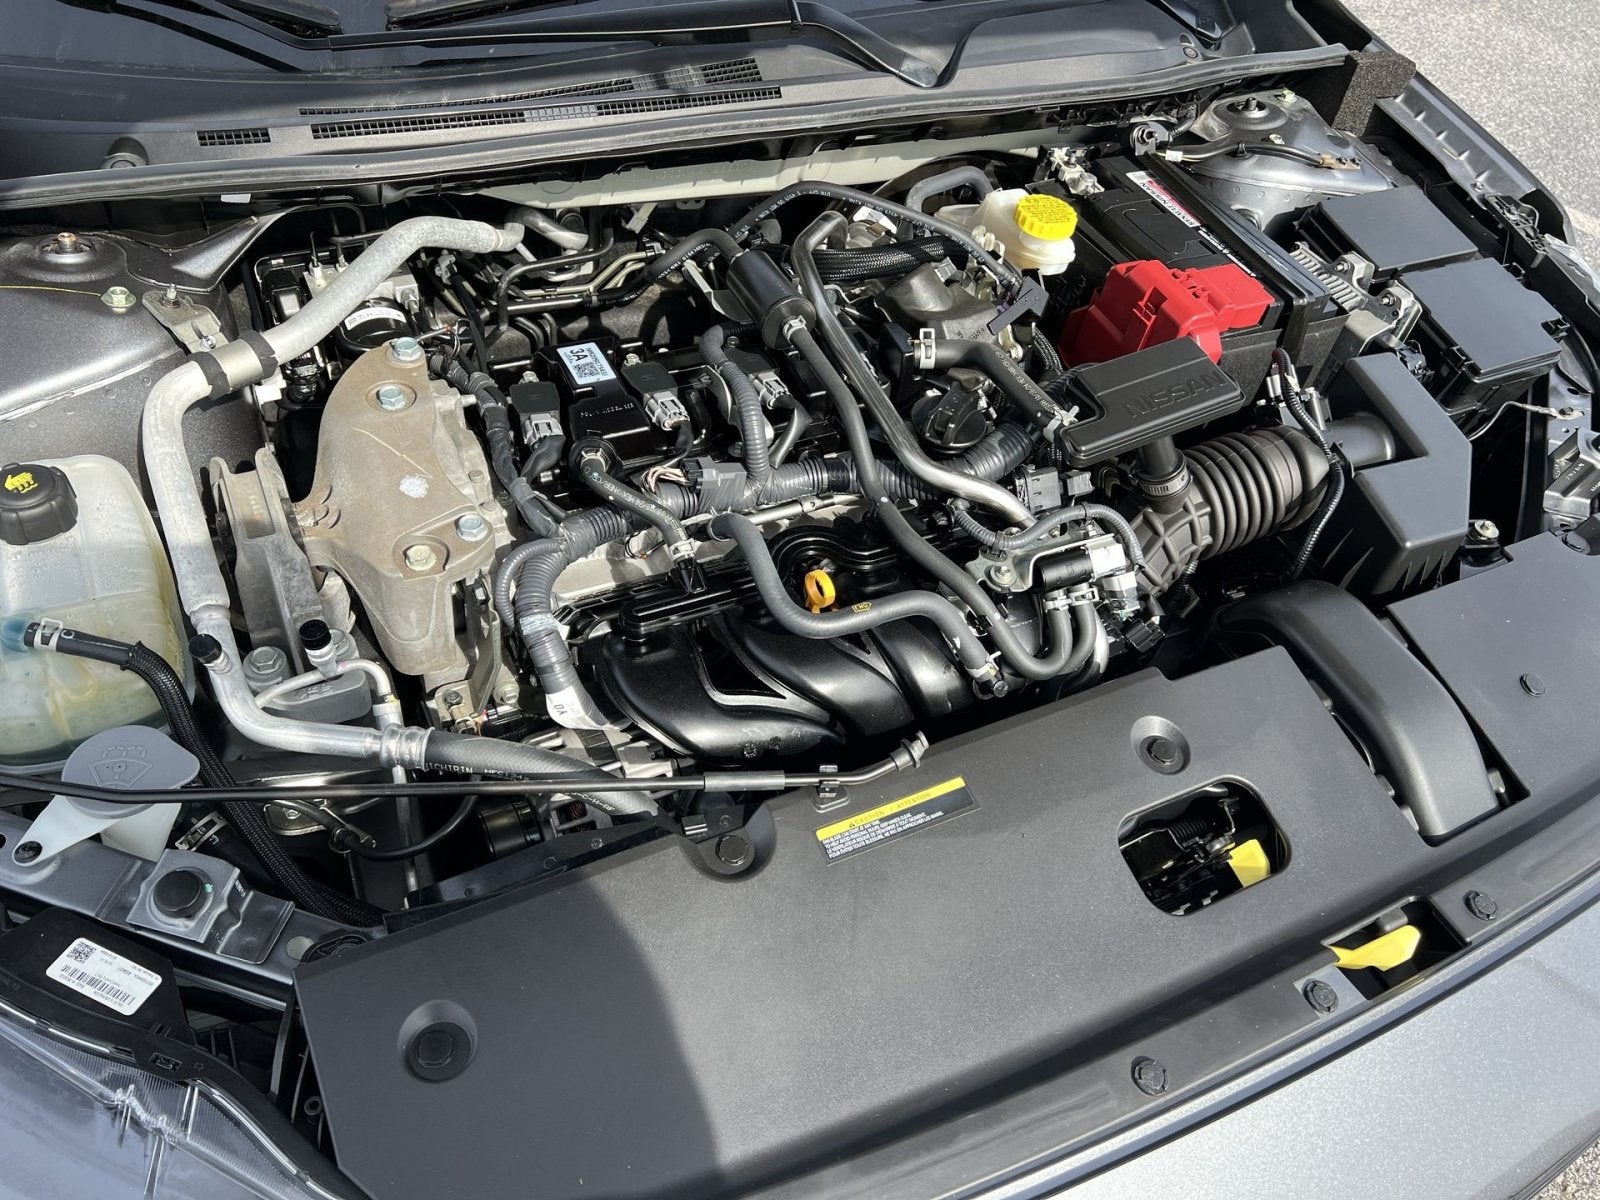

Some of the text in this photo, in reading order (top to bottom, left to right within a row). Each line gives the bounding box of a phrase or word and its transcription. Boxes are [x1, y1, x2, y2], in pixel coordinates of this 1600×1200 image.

[570, 348, 588, 361] 3A
[1122, 370, 1229, 419] NISSAN
[854, 810, 884, 825] CAUTION
[896, 792, 931, 809] ATTENTION
